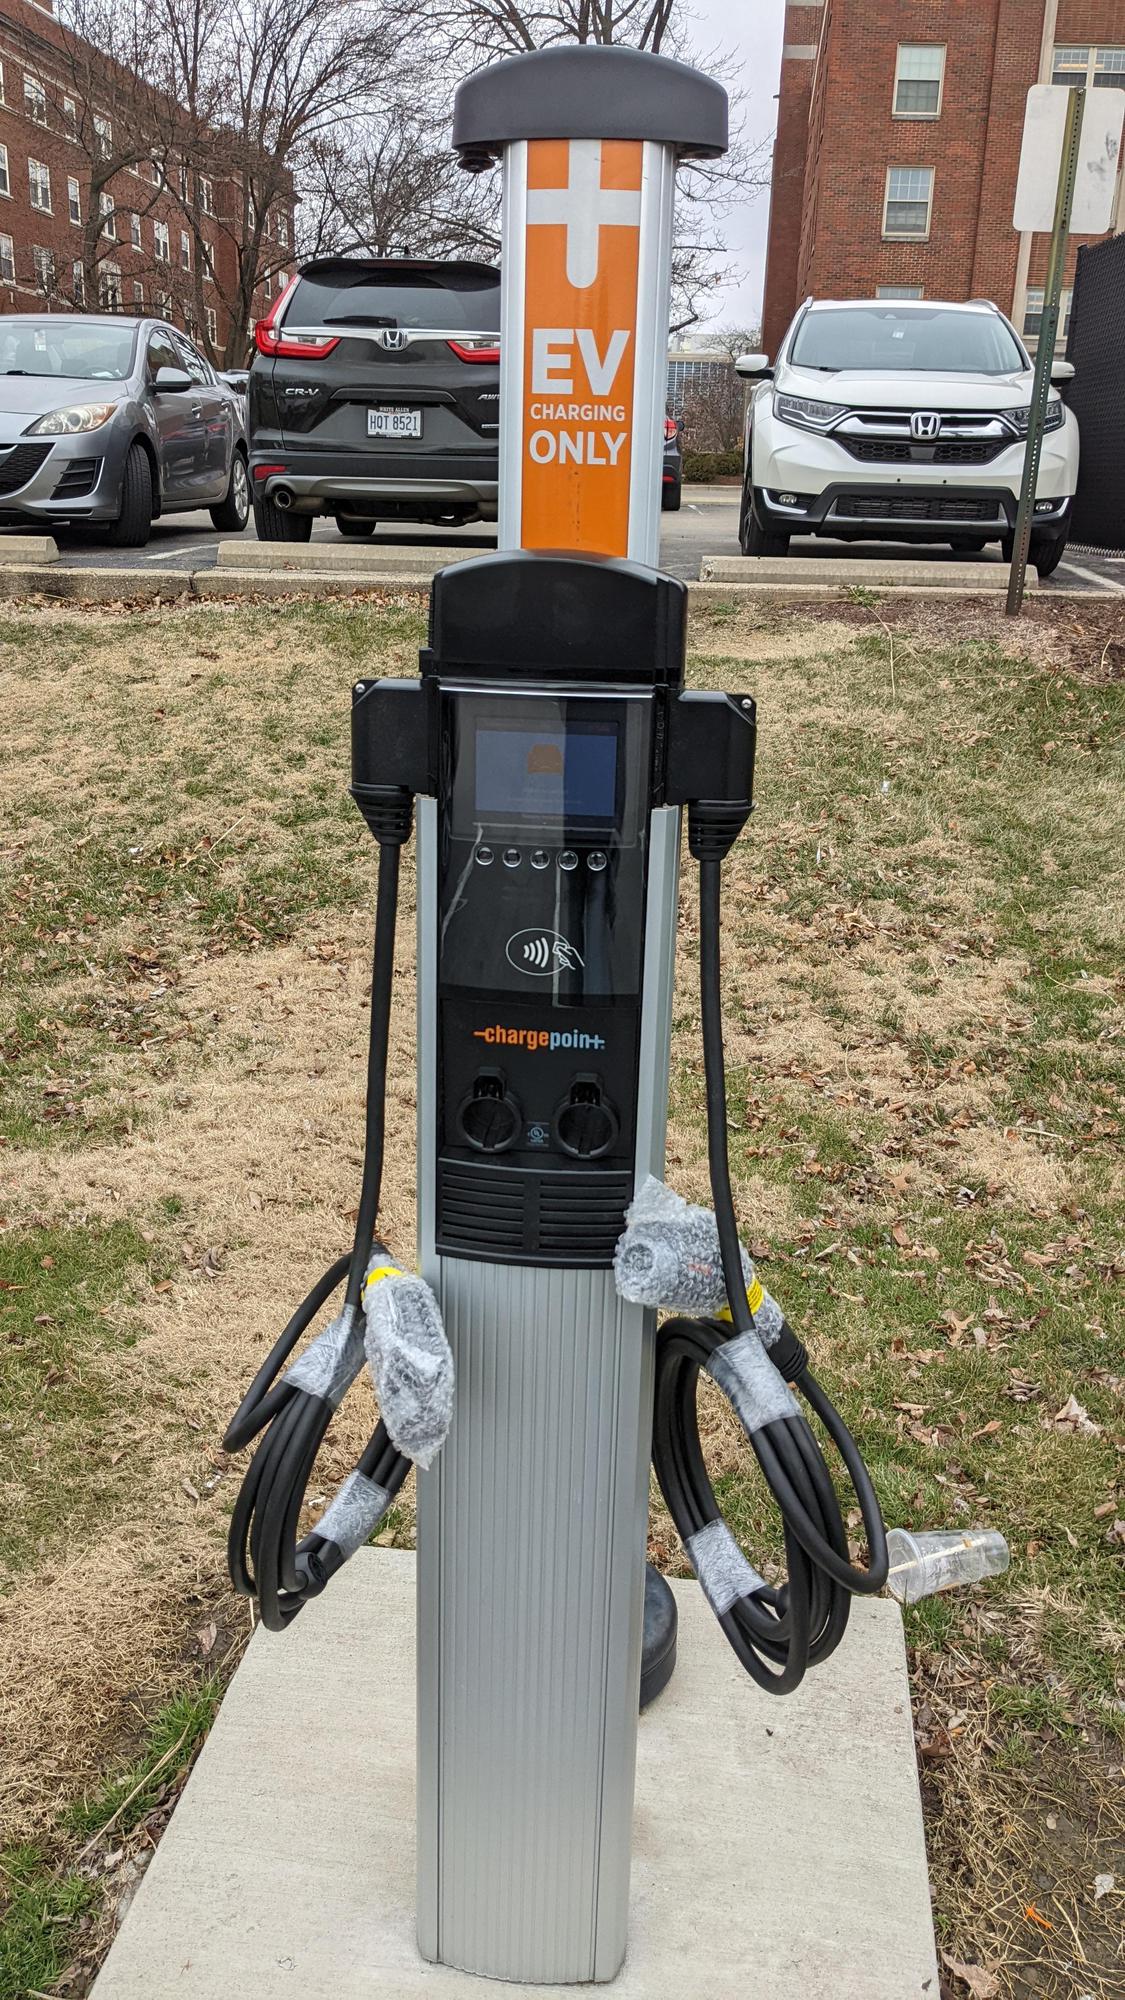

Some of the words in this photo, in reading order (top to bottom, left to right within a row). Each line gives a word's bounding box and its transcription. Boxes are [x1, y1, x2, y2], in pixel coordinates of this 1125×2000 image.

[531, 328, 631, 396] EV
[285, 388, 319, 396] CR-V
[530, 403, 625, 422] CHARGING
[370, 415, 390, 430] HQT
[392, 415, 417, 431] 8521
[529, 429, 628, 466] ONLY
